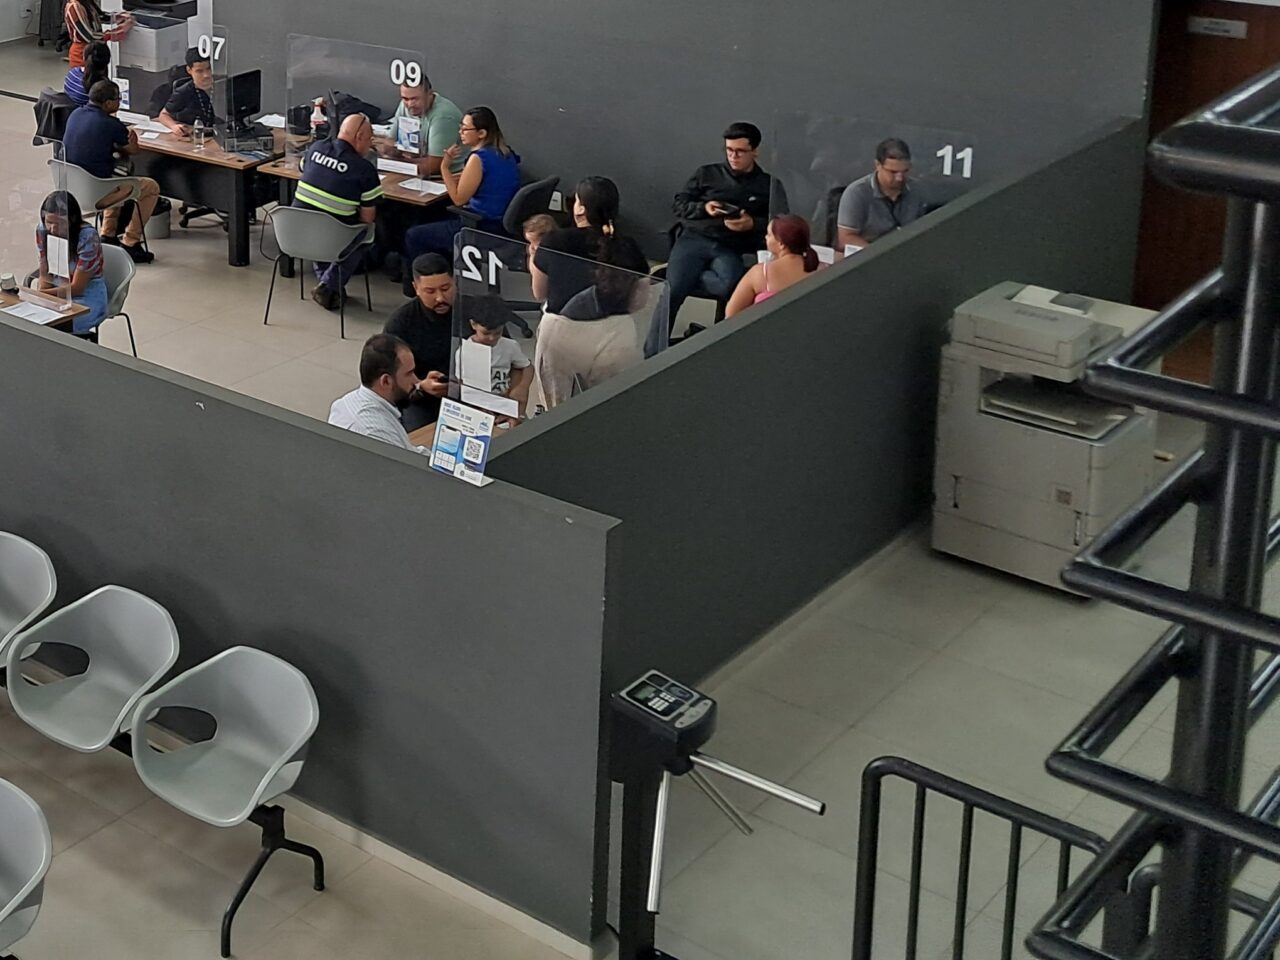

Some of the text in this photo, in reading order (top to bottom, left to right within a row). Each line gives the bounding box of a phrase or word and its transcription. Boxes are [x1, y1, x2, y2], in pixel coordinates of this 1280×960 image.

[198, 34, 225, 60] 07
[390, 59, 422, 88] 09
[310, 151, 349, 173] rumo
[936, 145, 973, 178] 11
